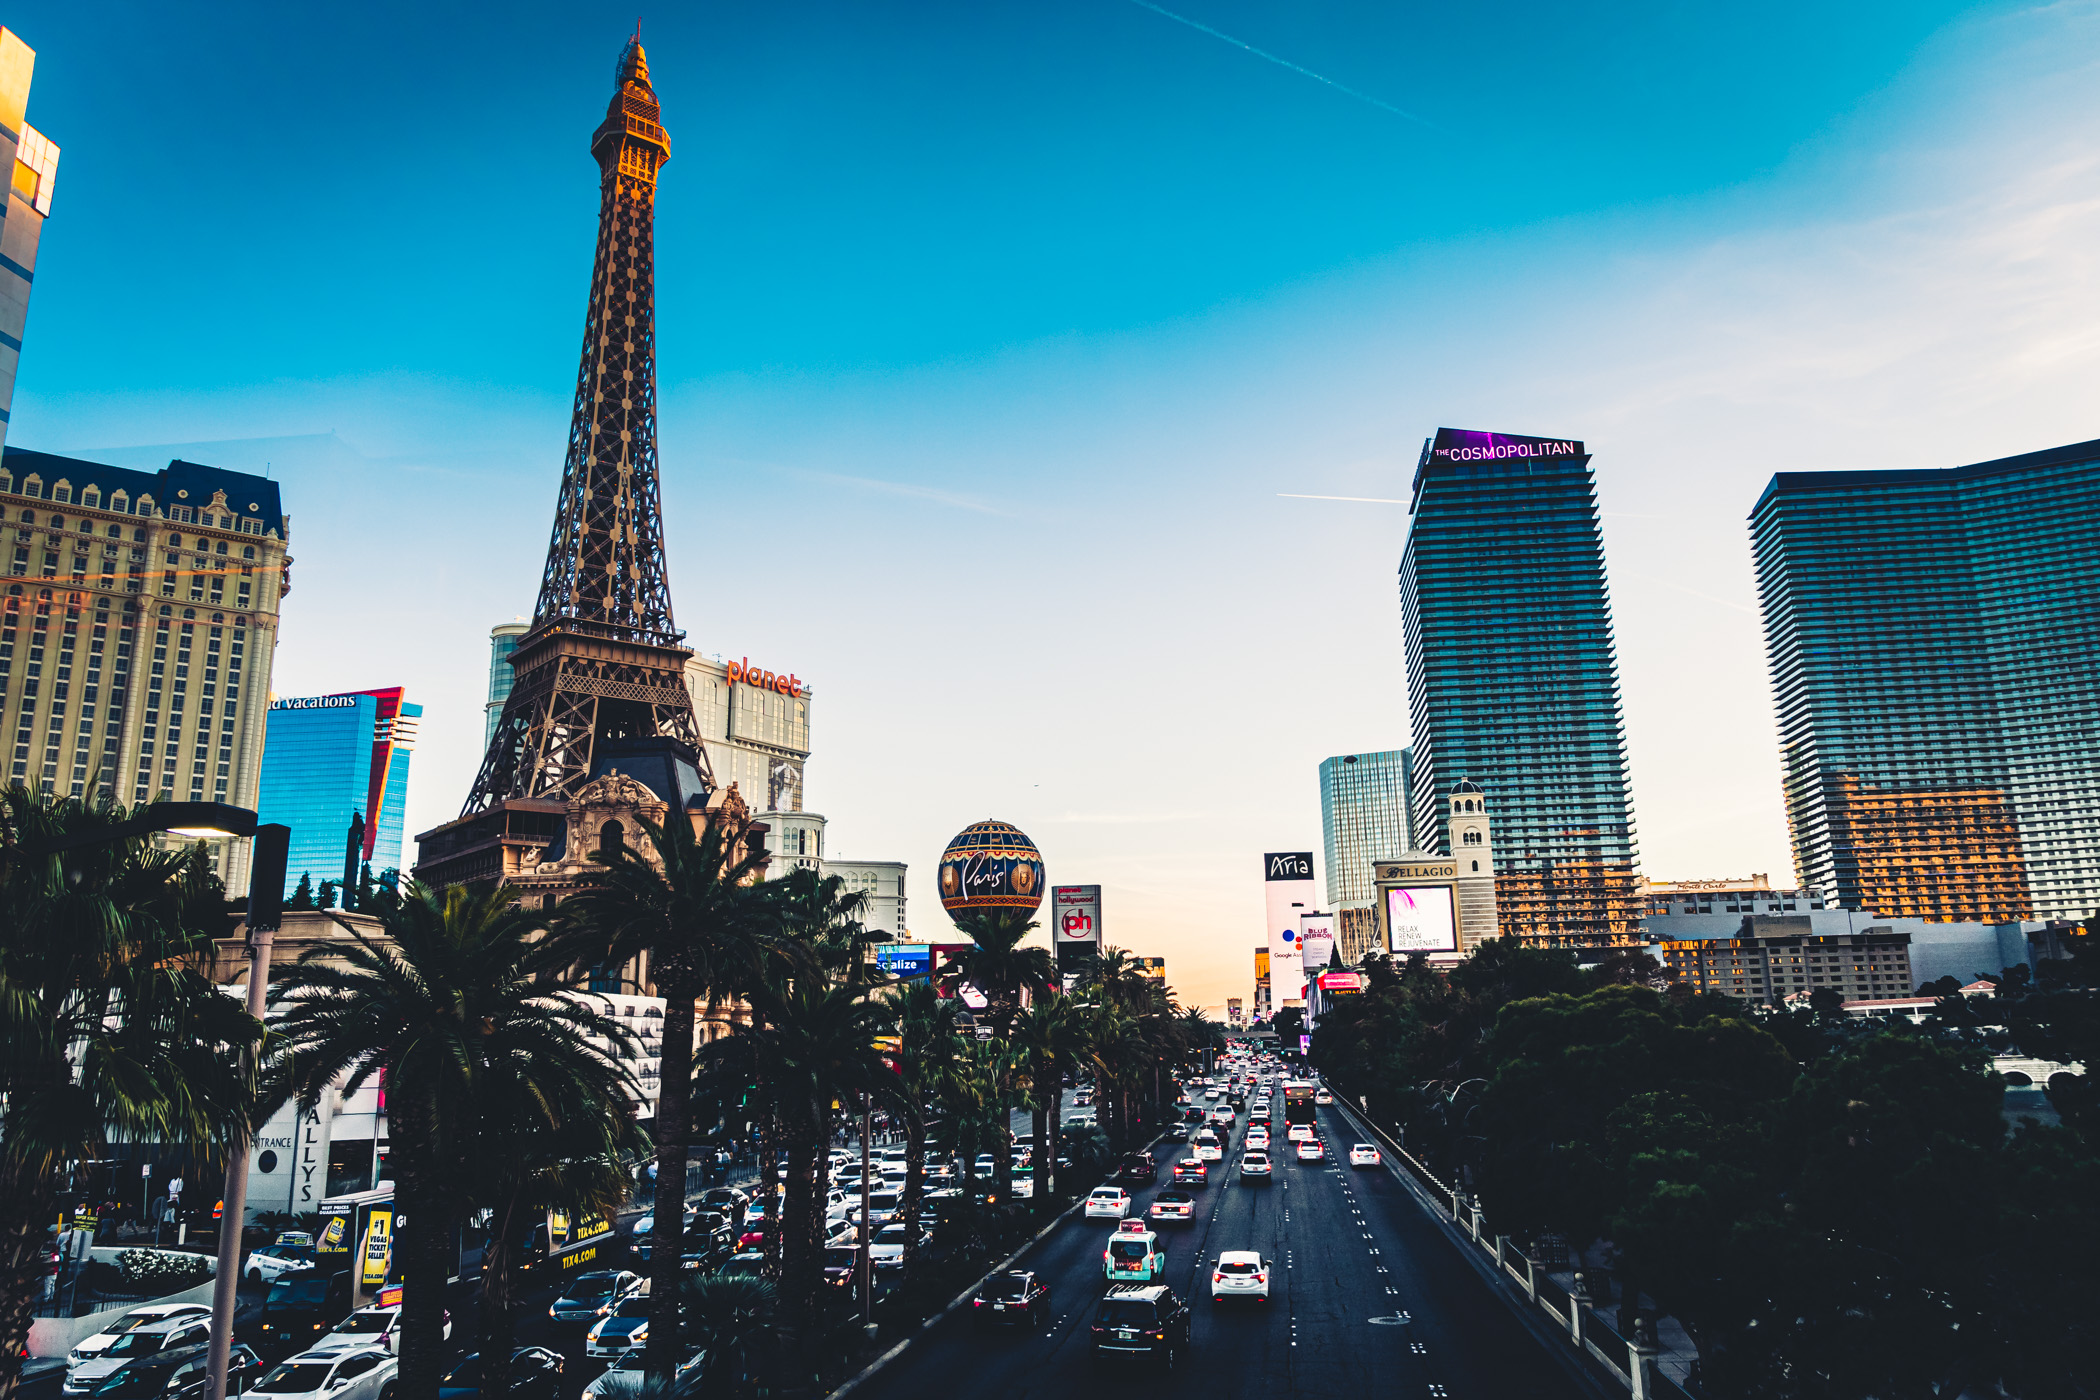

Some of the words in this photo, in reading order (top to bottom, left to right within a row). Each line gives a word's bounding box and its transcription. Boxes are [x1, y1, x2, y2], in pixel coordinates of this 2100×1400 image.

[1451, 442, 1574, 461] COSMOPOLITAN
[727, 656, 802, 698] planet
[286, 695, 356, 709] Vacations
[1270, 855, 1308, 877] Aria
[1383, 867, 1453, 878] BELLAGIO
[962, 850, 1004, 901] Paris
[1058, 887, 1082, 895] planet
[1058, 895, 1094, 904] hollywood
[1064, 908, 1092, 936] ph
[1398, 939, 1440, 947] REJUVENATE
[1274, 952, 1292, 960] Google
[251, 1138, 291, 1148] TRANCE
[301, 1097, 321, 1202] ALLYS
[374, 1219, 385, 1235] #1
[577, 1220, 609, 1240] TIX4.COM
[368, 1252, 386, 1260] SELLER
[562, 1247, 596, 1270] TIX4.COM
